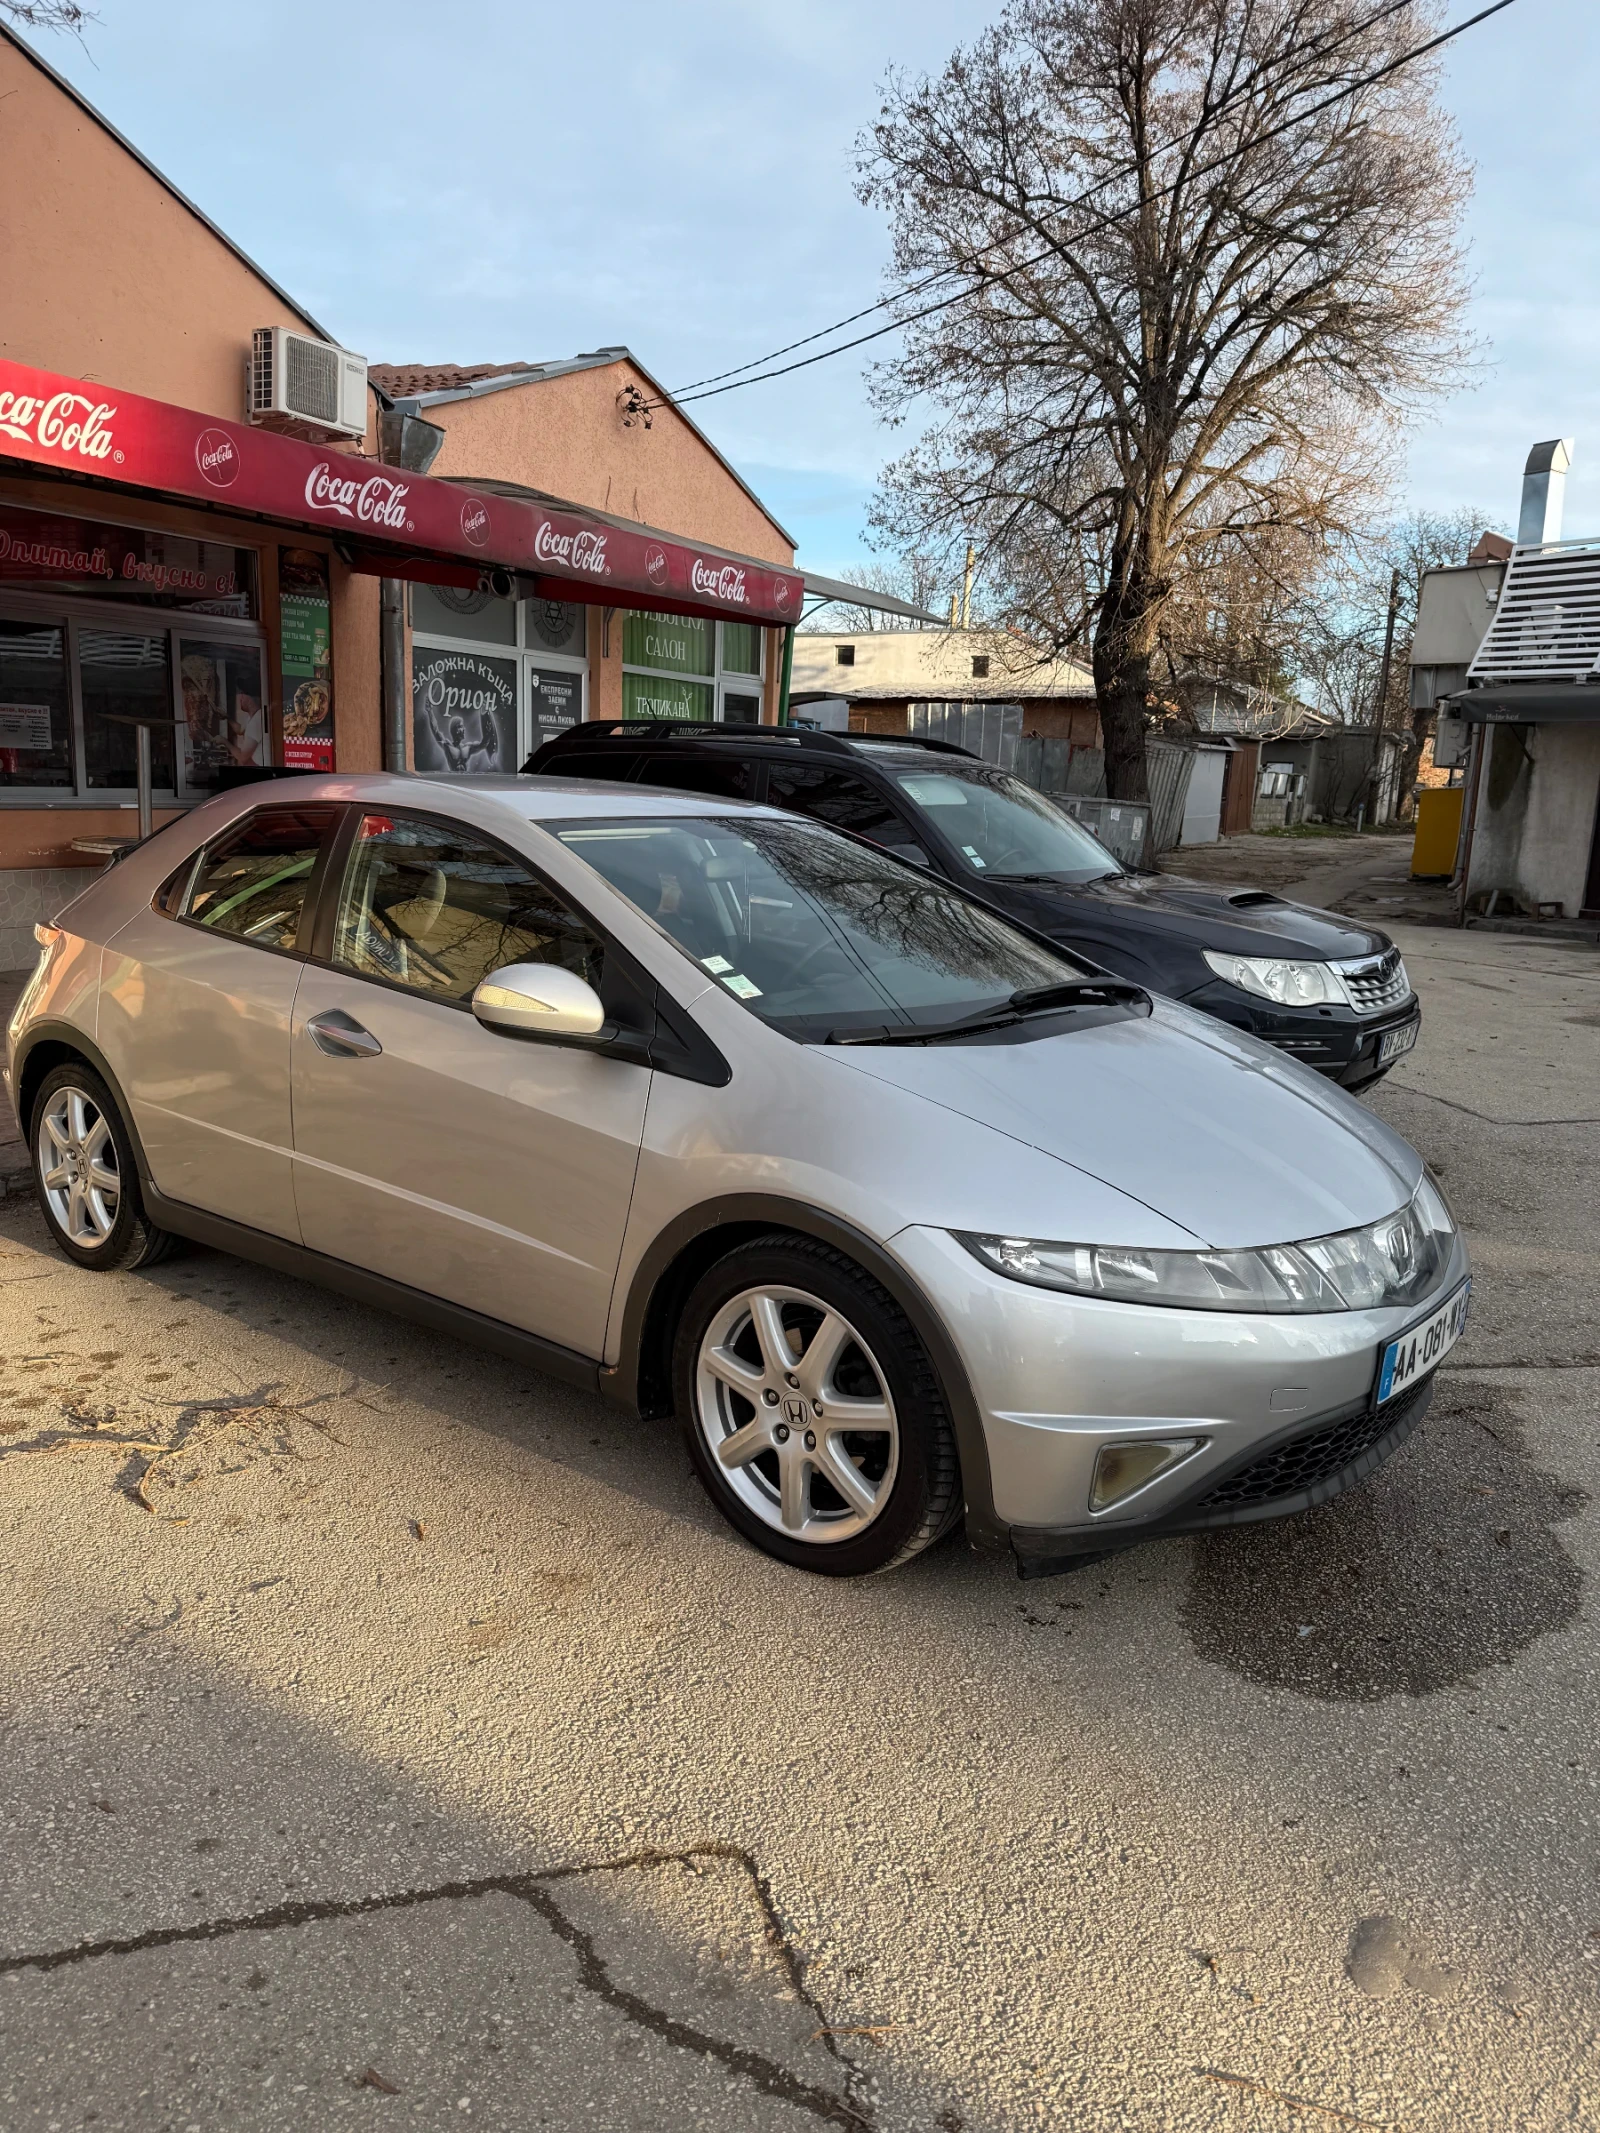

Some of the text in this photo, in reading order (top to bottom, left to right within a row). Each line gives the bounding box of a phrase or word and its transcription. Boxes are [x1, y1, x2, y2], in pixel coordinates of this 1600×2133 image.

[0, 392, 117, 459] ca-Cola
[202, 442, 233, 470] Coca-Cola
[305, 462, 410, 529] Coca-Cola
[465, 510, 486, 533] Coca-Cola
[534, 521, 608, 574] Coca-Cola
[122, 553, 207, 592] вкусно
[215, 571, 236, 594] е!
[692, 558, 746, 603] Coca-Cola
[645, 635, 686, 661] САЛОН
[412, 657, 514, 705] ЗАЛОЖНА КЪЩА
[428, 677, 498, 718] Орион
[636, 696, 691, 719] ТРОПИКАНА
